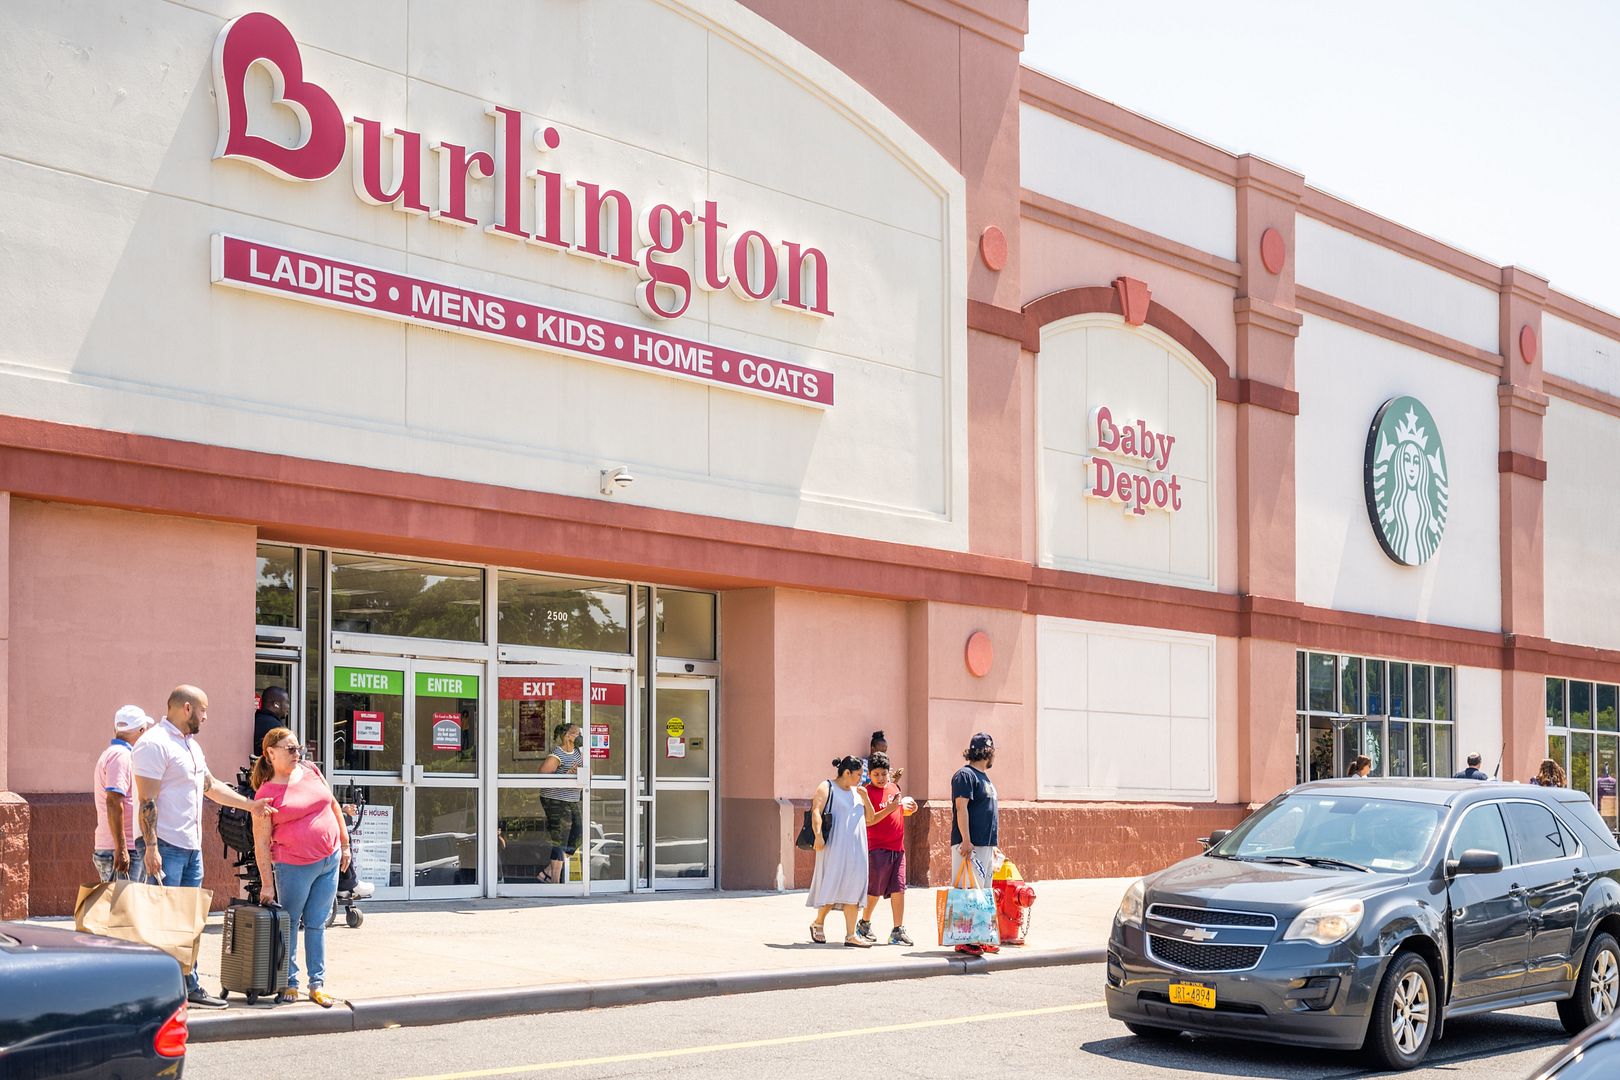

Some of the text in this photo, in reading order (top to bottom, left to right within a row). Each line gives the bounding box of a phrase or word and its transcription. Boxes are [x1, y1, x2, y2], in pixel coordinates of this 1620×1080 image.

[213, 11, 835, 320] Burlington
[249, 247, 819, 398] LADIES MENS KIDS HOME COATS
[1095, 405, 1176, 471] Baby
[1090, 456, 1182, 516] Depot
[547, 610, 568, 621] 2500
[350, 672, 389, 690] ENTER
[427, 677, 463, 694] ENTER
[523, 681, 555, 697] EXIT
[591, 687, 607, 701] XIT
[369, 809, 389, 817] HOURS
